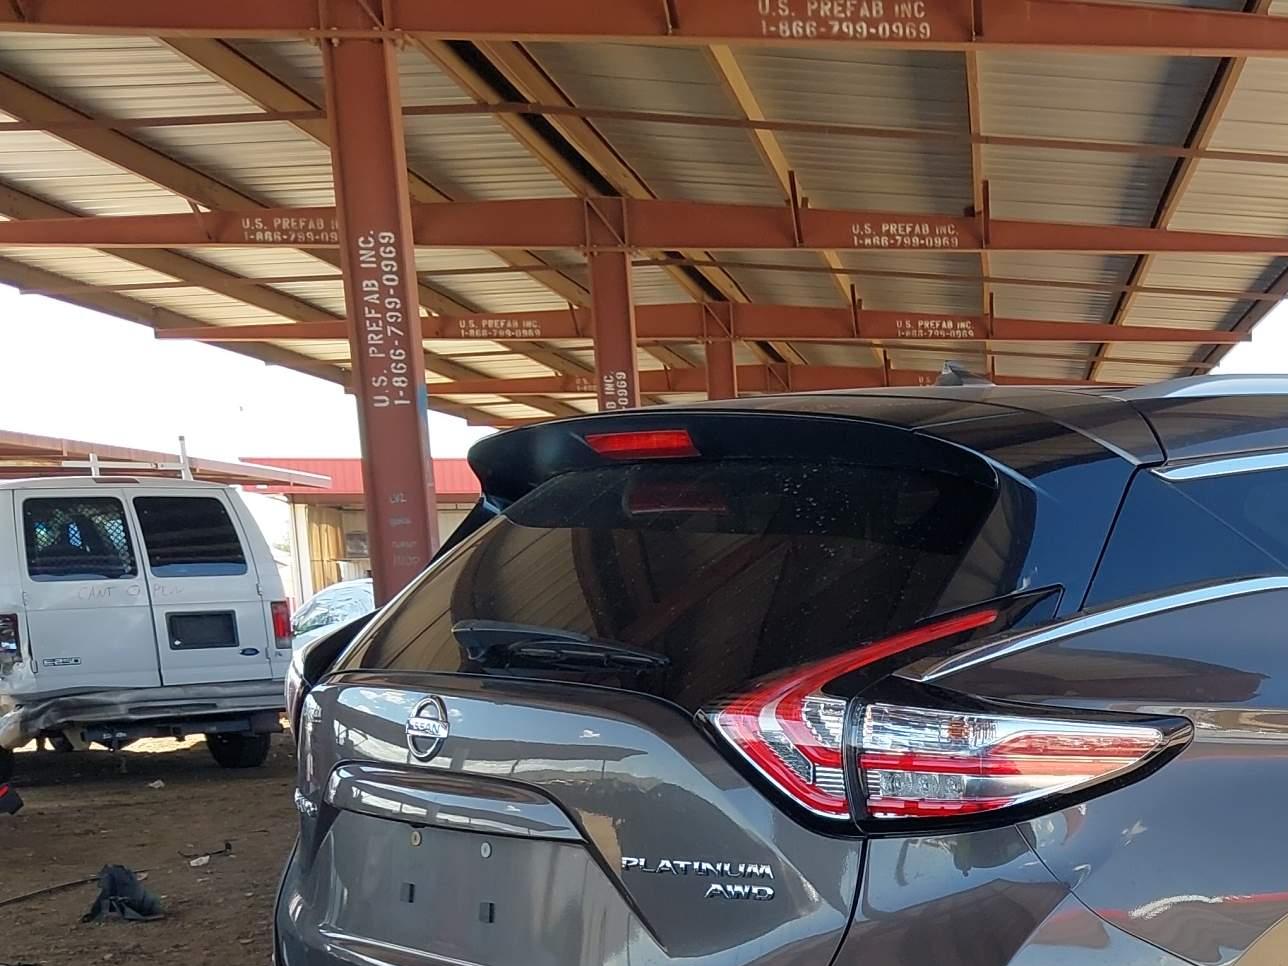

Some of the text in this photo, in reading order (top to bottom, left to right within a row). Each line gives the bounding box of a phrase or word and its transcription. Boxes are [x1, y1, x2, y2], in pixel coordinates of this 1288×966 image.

[758, 0, 796, 17] U.S.
[807, 0, 884, 18] PREFAB
[760, 20, 931, 39] 1-866-799-0969
[242, 218, 268, 230] U.S.
[273, 218, 325, 230] PREFAB
[852, 223, 876, 235] U.S.
[881, 223, 930, 235] PREFAB
[853, 236, 959, 248] 1-866-799-0969
[358, 230, 391, 407] U.S. PREFAB INC.
[378, 231, 411, 406] 1-866-799-0969
[621, 856, 775, 880] PLATINUM
[704, 883, 775, 901] AWD
